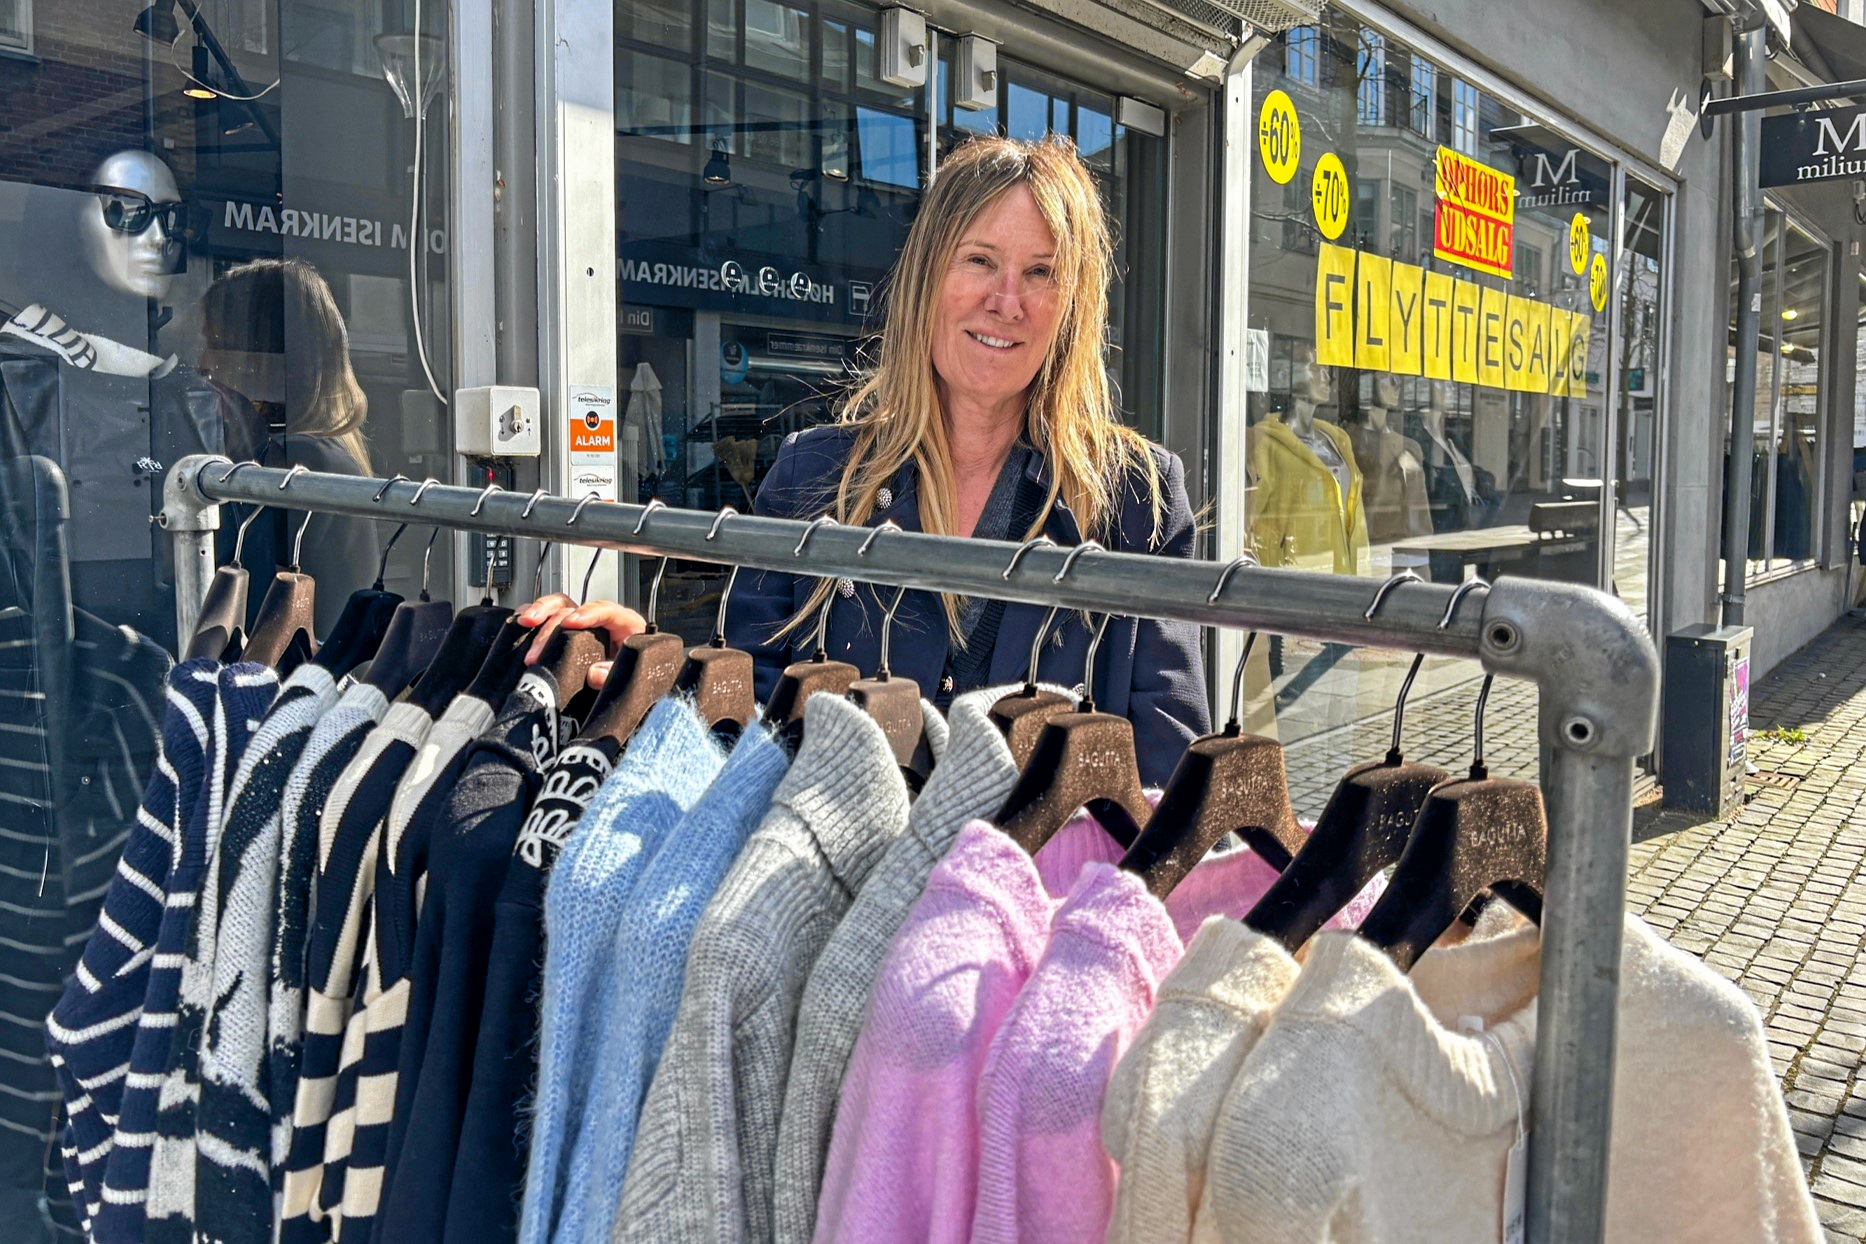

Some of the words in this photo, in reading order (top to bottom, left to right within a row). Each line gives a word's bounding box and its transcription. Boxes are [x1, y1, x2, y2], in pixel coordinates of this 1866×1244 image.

[1812, 113, 1866, 156] M
[1796, 155, 1866, 180] miliu
[1439, 204, 1510, 267] UDSALG
[1324, 272, 1586, 381] FLYTTESALG
[575, 435, 611, 446] ALARM
[1077, 750, 1122, 768] BAGUTTA
